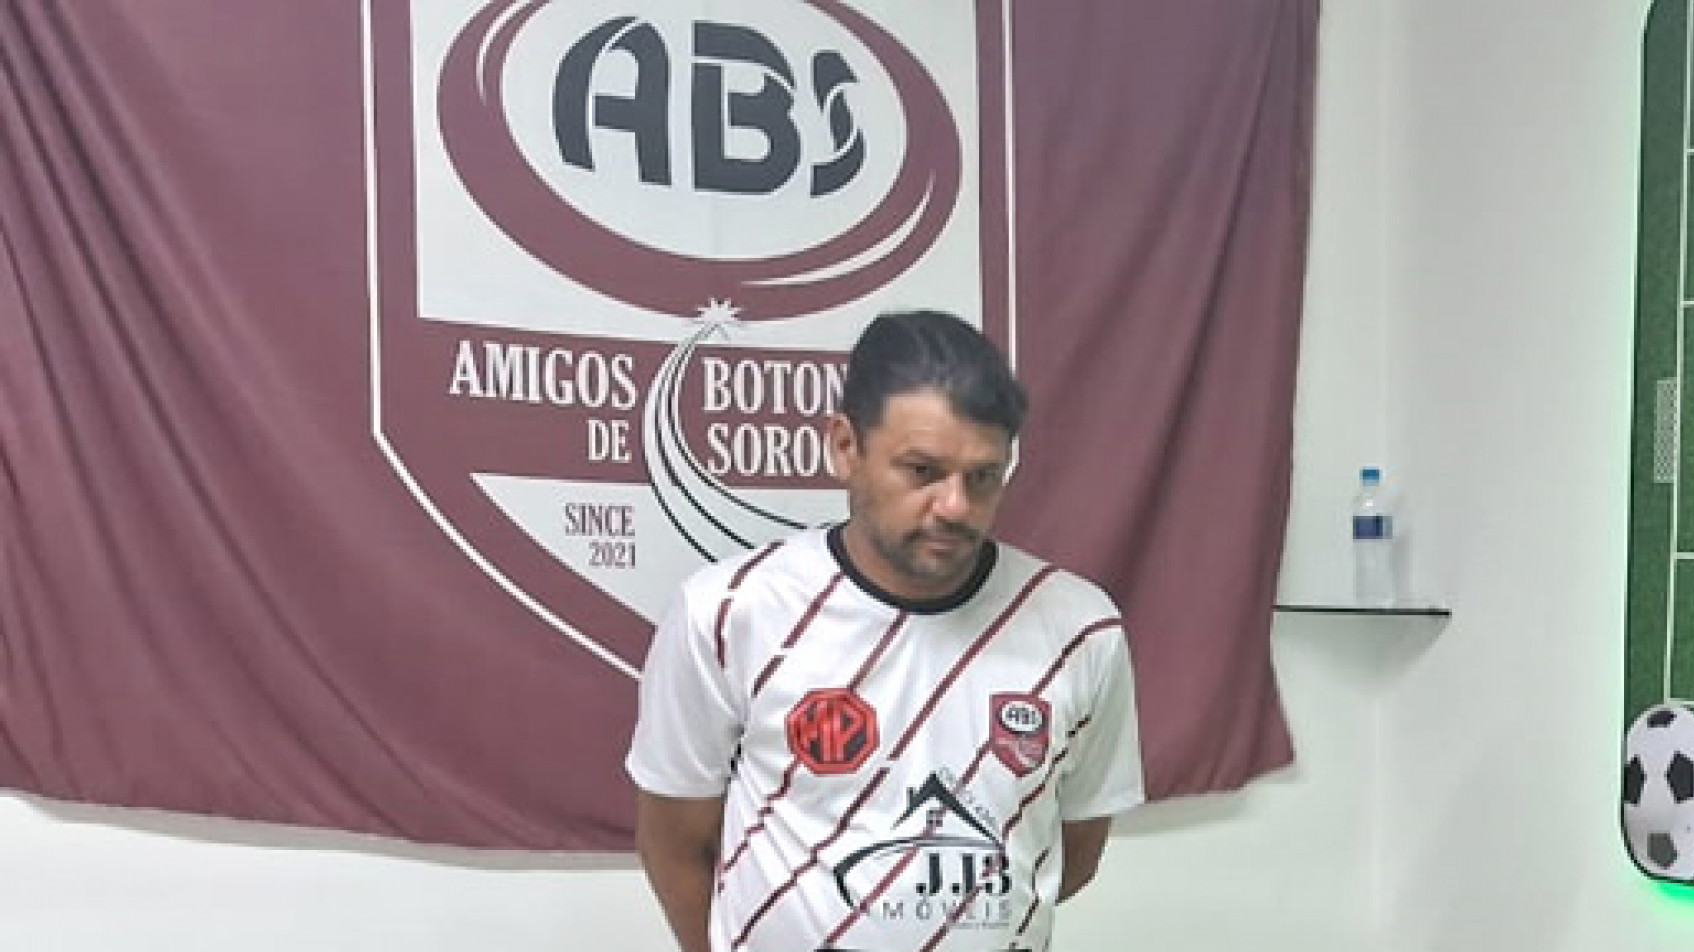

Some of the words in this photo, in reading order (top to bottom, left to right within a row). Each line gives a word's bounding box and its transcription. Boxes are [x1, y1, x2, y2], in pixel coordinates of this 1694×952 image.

[552, 16, 866, 198] ABS
[450, 341, 638, 410] AMIGOS
[587, 419, 631, 464] DE
[564, 503, 635, 536] SINCE
[588, 540, 636, 568] 2021
